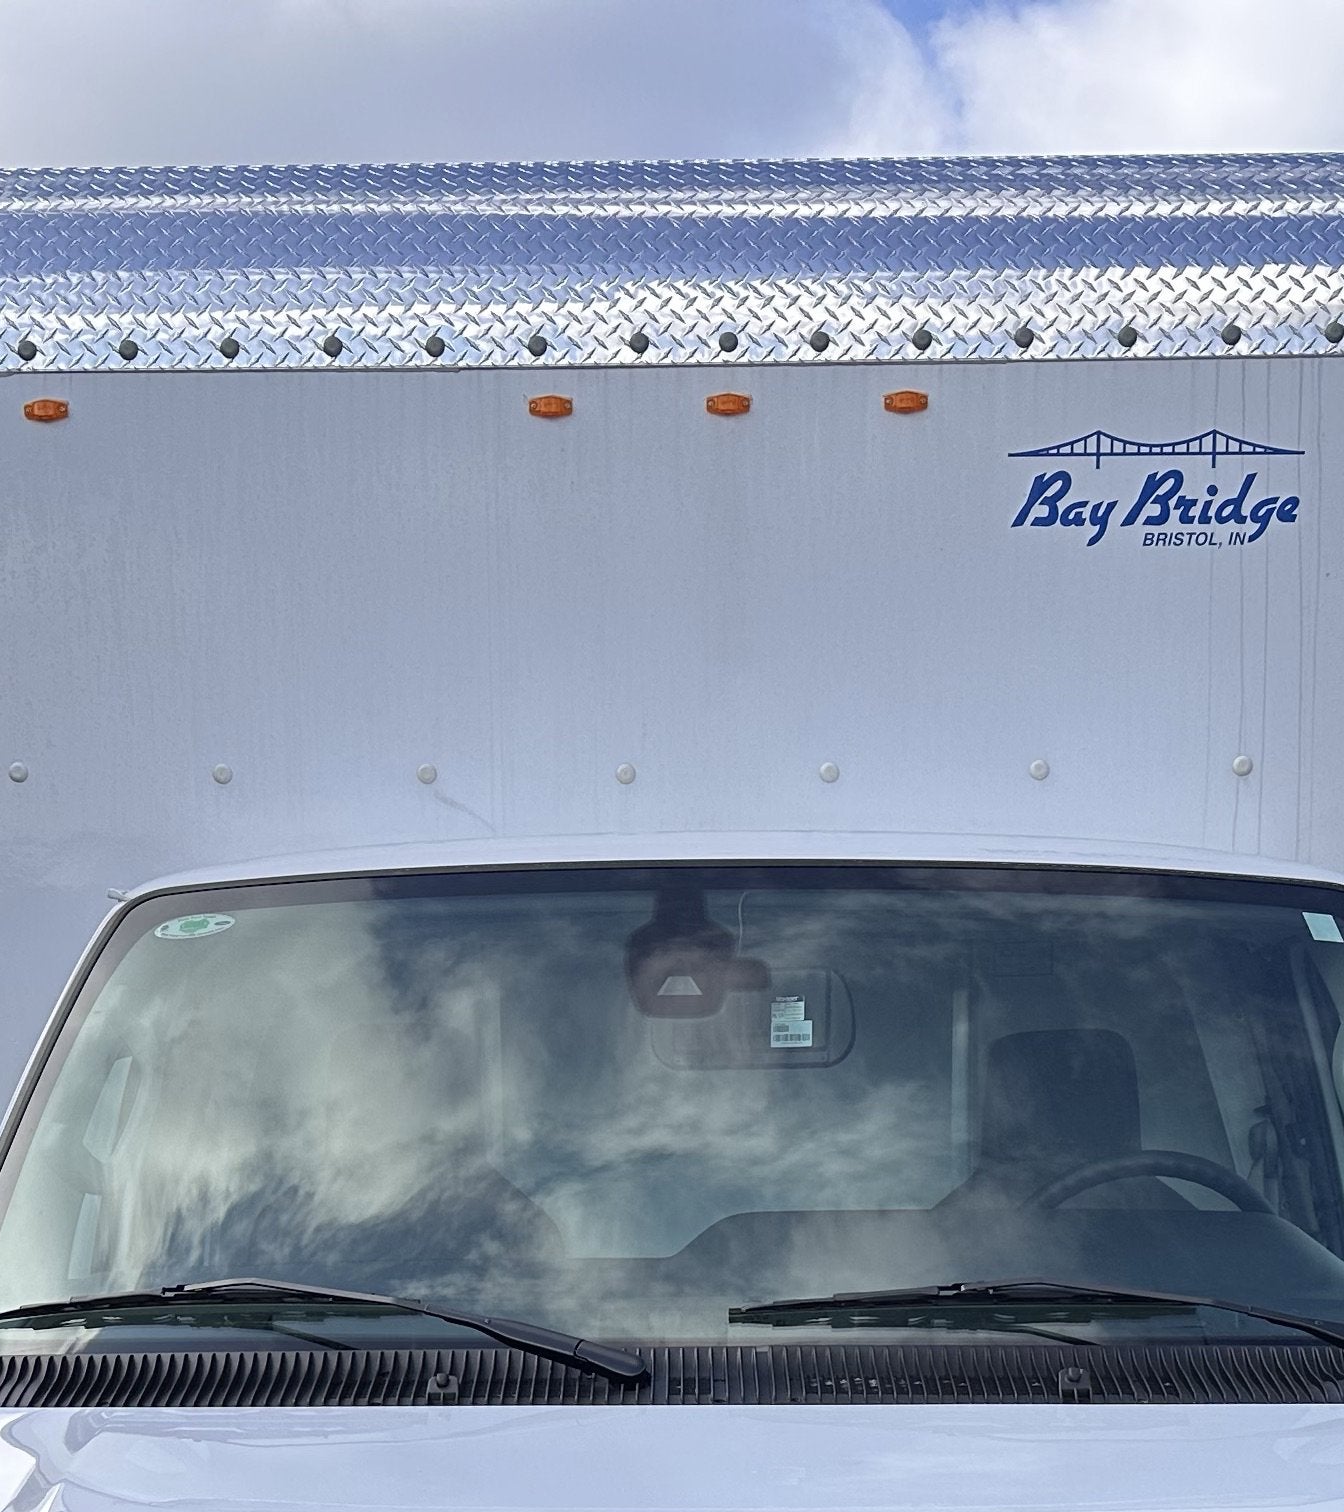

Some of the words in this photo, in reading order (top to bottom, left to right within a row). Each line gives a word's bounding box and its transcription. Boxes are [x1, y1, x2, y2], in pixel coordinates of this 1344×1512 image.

[1011, 469, 1119, 547] Bay
[1119, 469, 1301, 544] Bridge
[1142, 532, 1223, 549] BRISTOL,
[1228, 532, 1246, 546] IN
